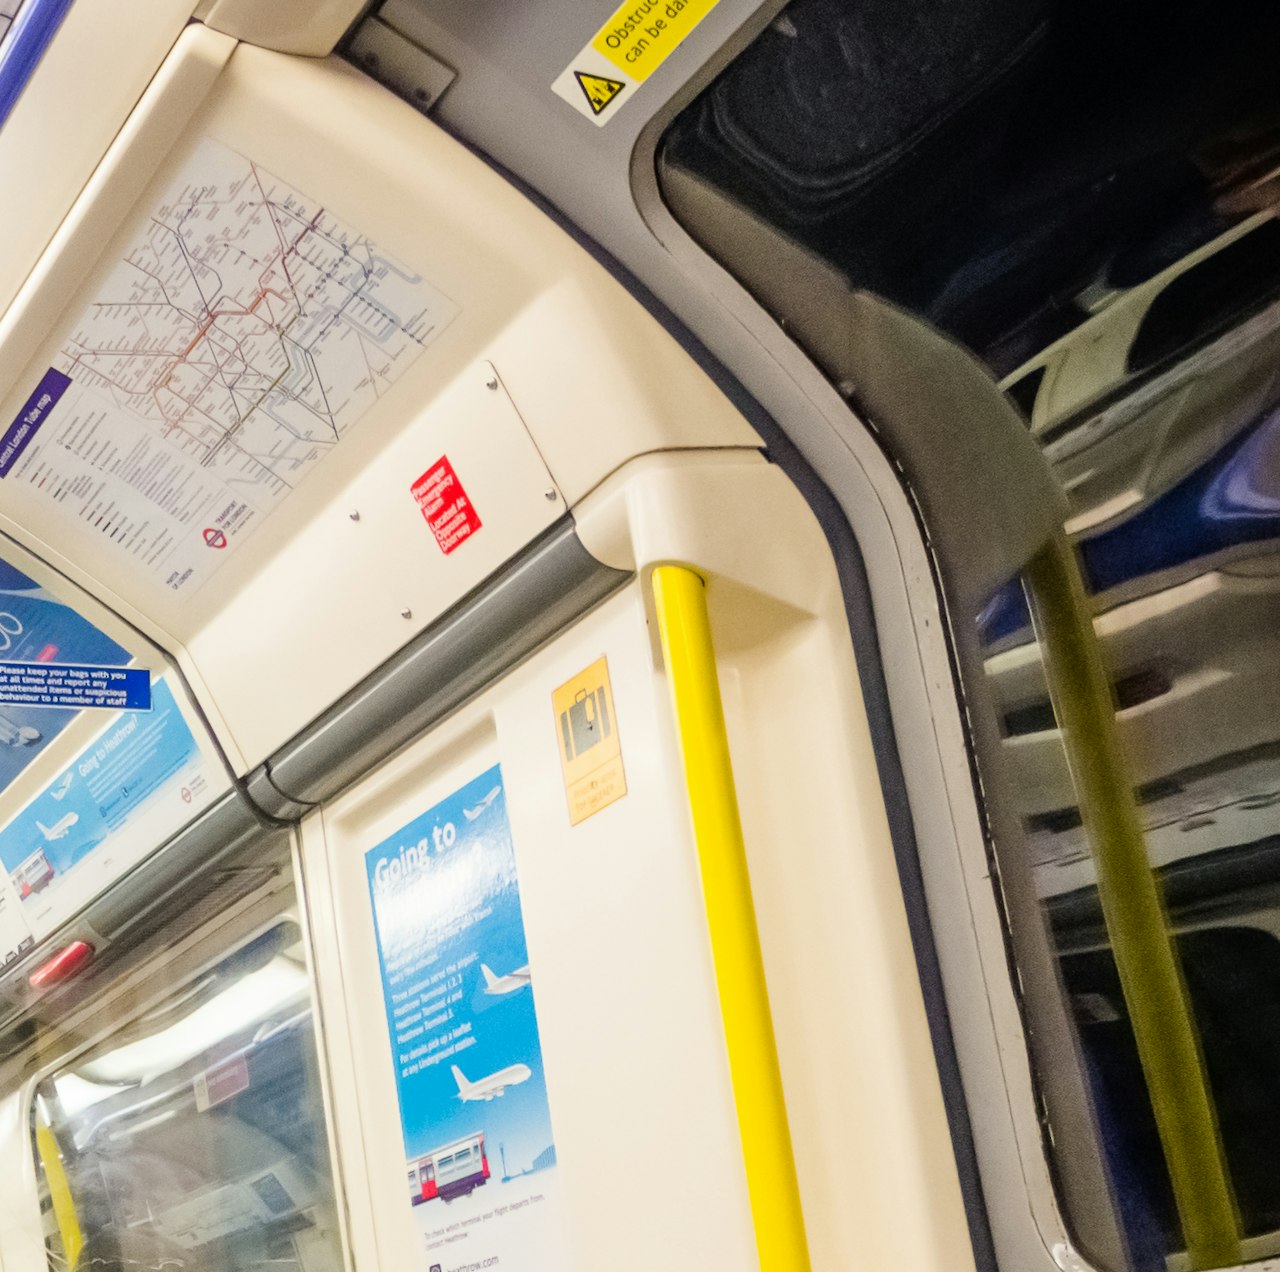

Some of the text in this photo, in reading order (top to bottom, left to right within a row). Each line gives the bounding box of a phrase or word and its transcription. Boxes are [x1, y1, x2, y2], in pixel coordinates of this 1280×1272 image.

[606, 0, 658, 49] Obstruc
[625, 37, 649, 63] can
[645, 18, 667, 38] be
[8, 423, 30, 448] London
[24, 407, 42, 424] Tube
[37, 393, 51, 410] map
[412, 466, 445, 501] Passenger
[424, 497, 444, 519] Alarm
[429, 497, 467, 531] Located At
[436, 511, 467, 540] Opposite
[440, 523, 470, 552] Doorway
[0, 666, 126, 681] Please keep your bags with you
[64, 679, 90, 687] report
[92, 680, 107, 689] any
[0, 685, 47, 693] unattended
[49, 686, 72, 694] items
[85, 689, 127, 697] suspicious
[0, 692, 40, 701] behaviour
[59, 696, 93, 704] member
[375, 822, 456, 885] Going to
